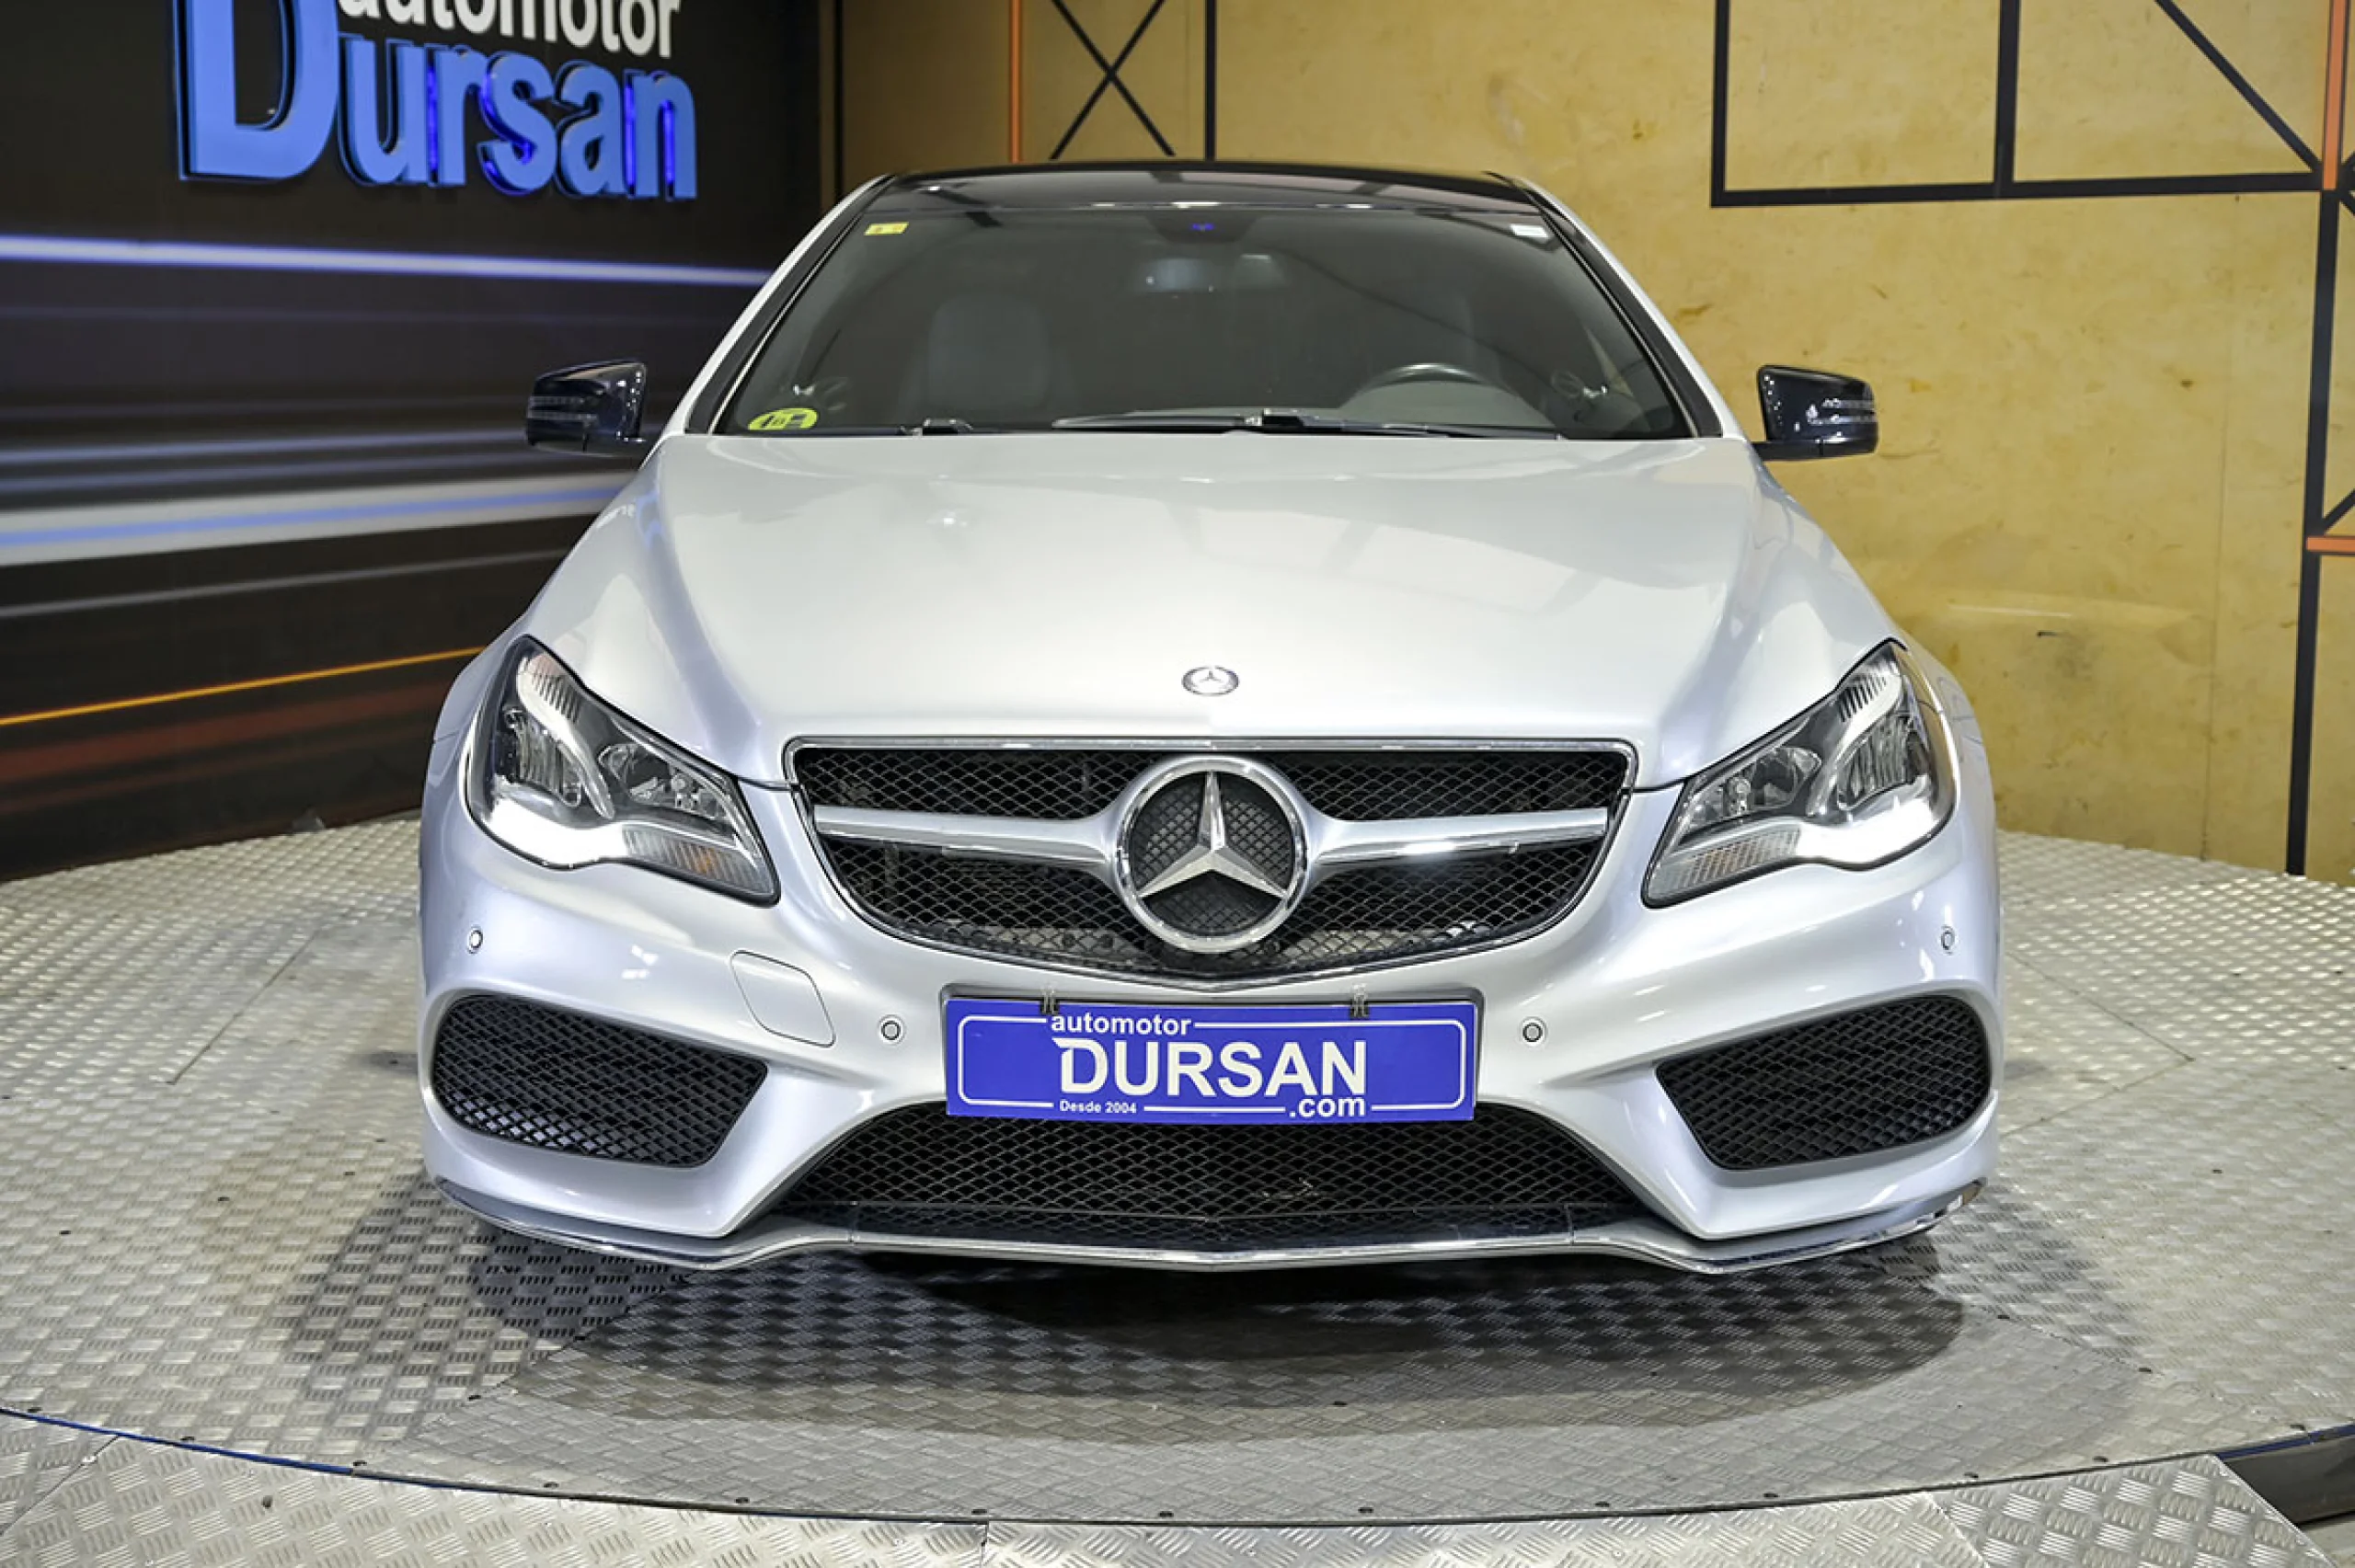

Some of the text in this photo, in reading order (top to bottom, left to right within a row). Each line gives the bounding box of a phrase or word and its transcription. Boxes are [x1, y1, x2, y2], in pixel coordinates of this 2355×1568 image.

[339, 0, 683, 59] motor
[174, 0, 697, 200] Dursan
[1051, 1012, 1192, 1036] automotor
[1051, 1037, 1367, 1097] DURSAN
[1059, 1099, 1137, 1114] Desde 2004
[1289, 1096, 1366, 1118] .com
